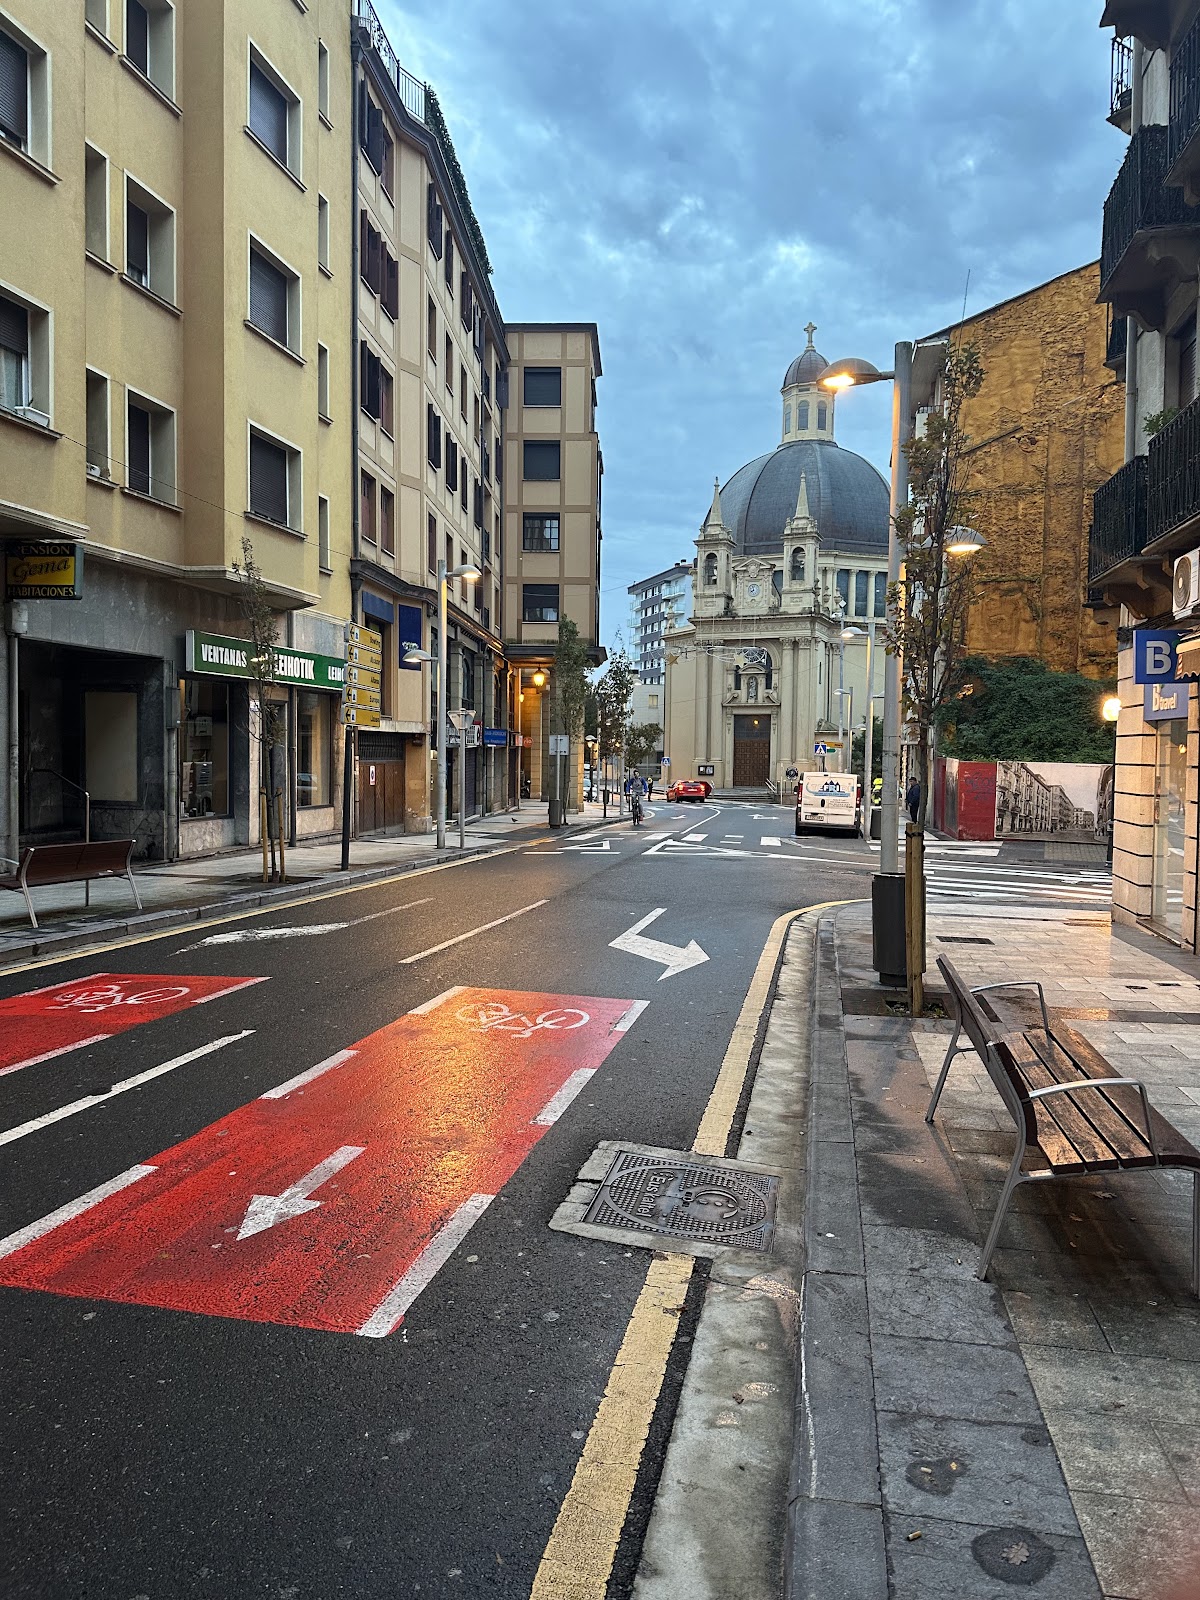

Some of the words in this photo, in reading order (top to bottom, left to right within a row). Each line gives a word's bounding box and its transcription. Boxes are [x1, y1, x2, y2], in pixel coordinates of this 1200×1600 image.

[17, 546, 70, 555] ENSION
[7, 587, 73, 596] HABITACIONES
[201, 643, 247, 668] VENTANAS
[635, 1175, 666, 1218] Euskaltel
